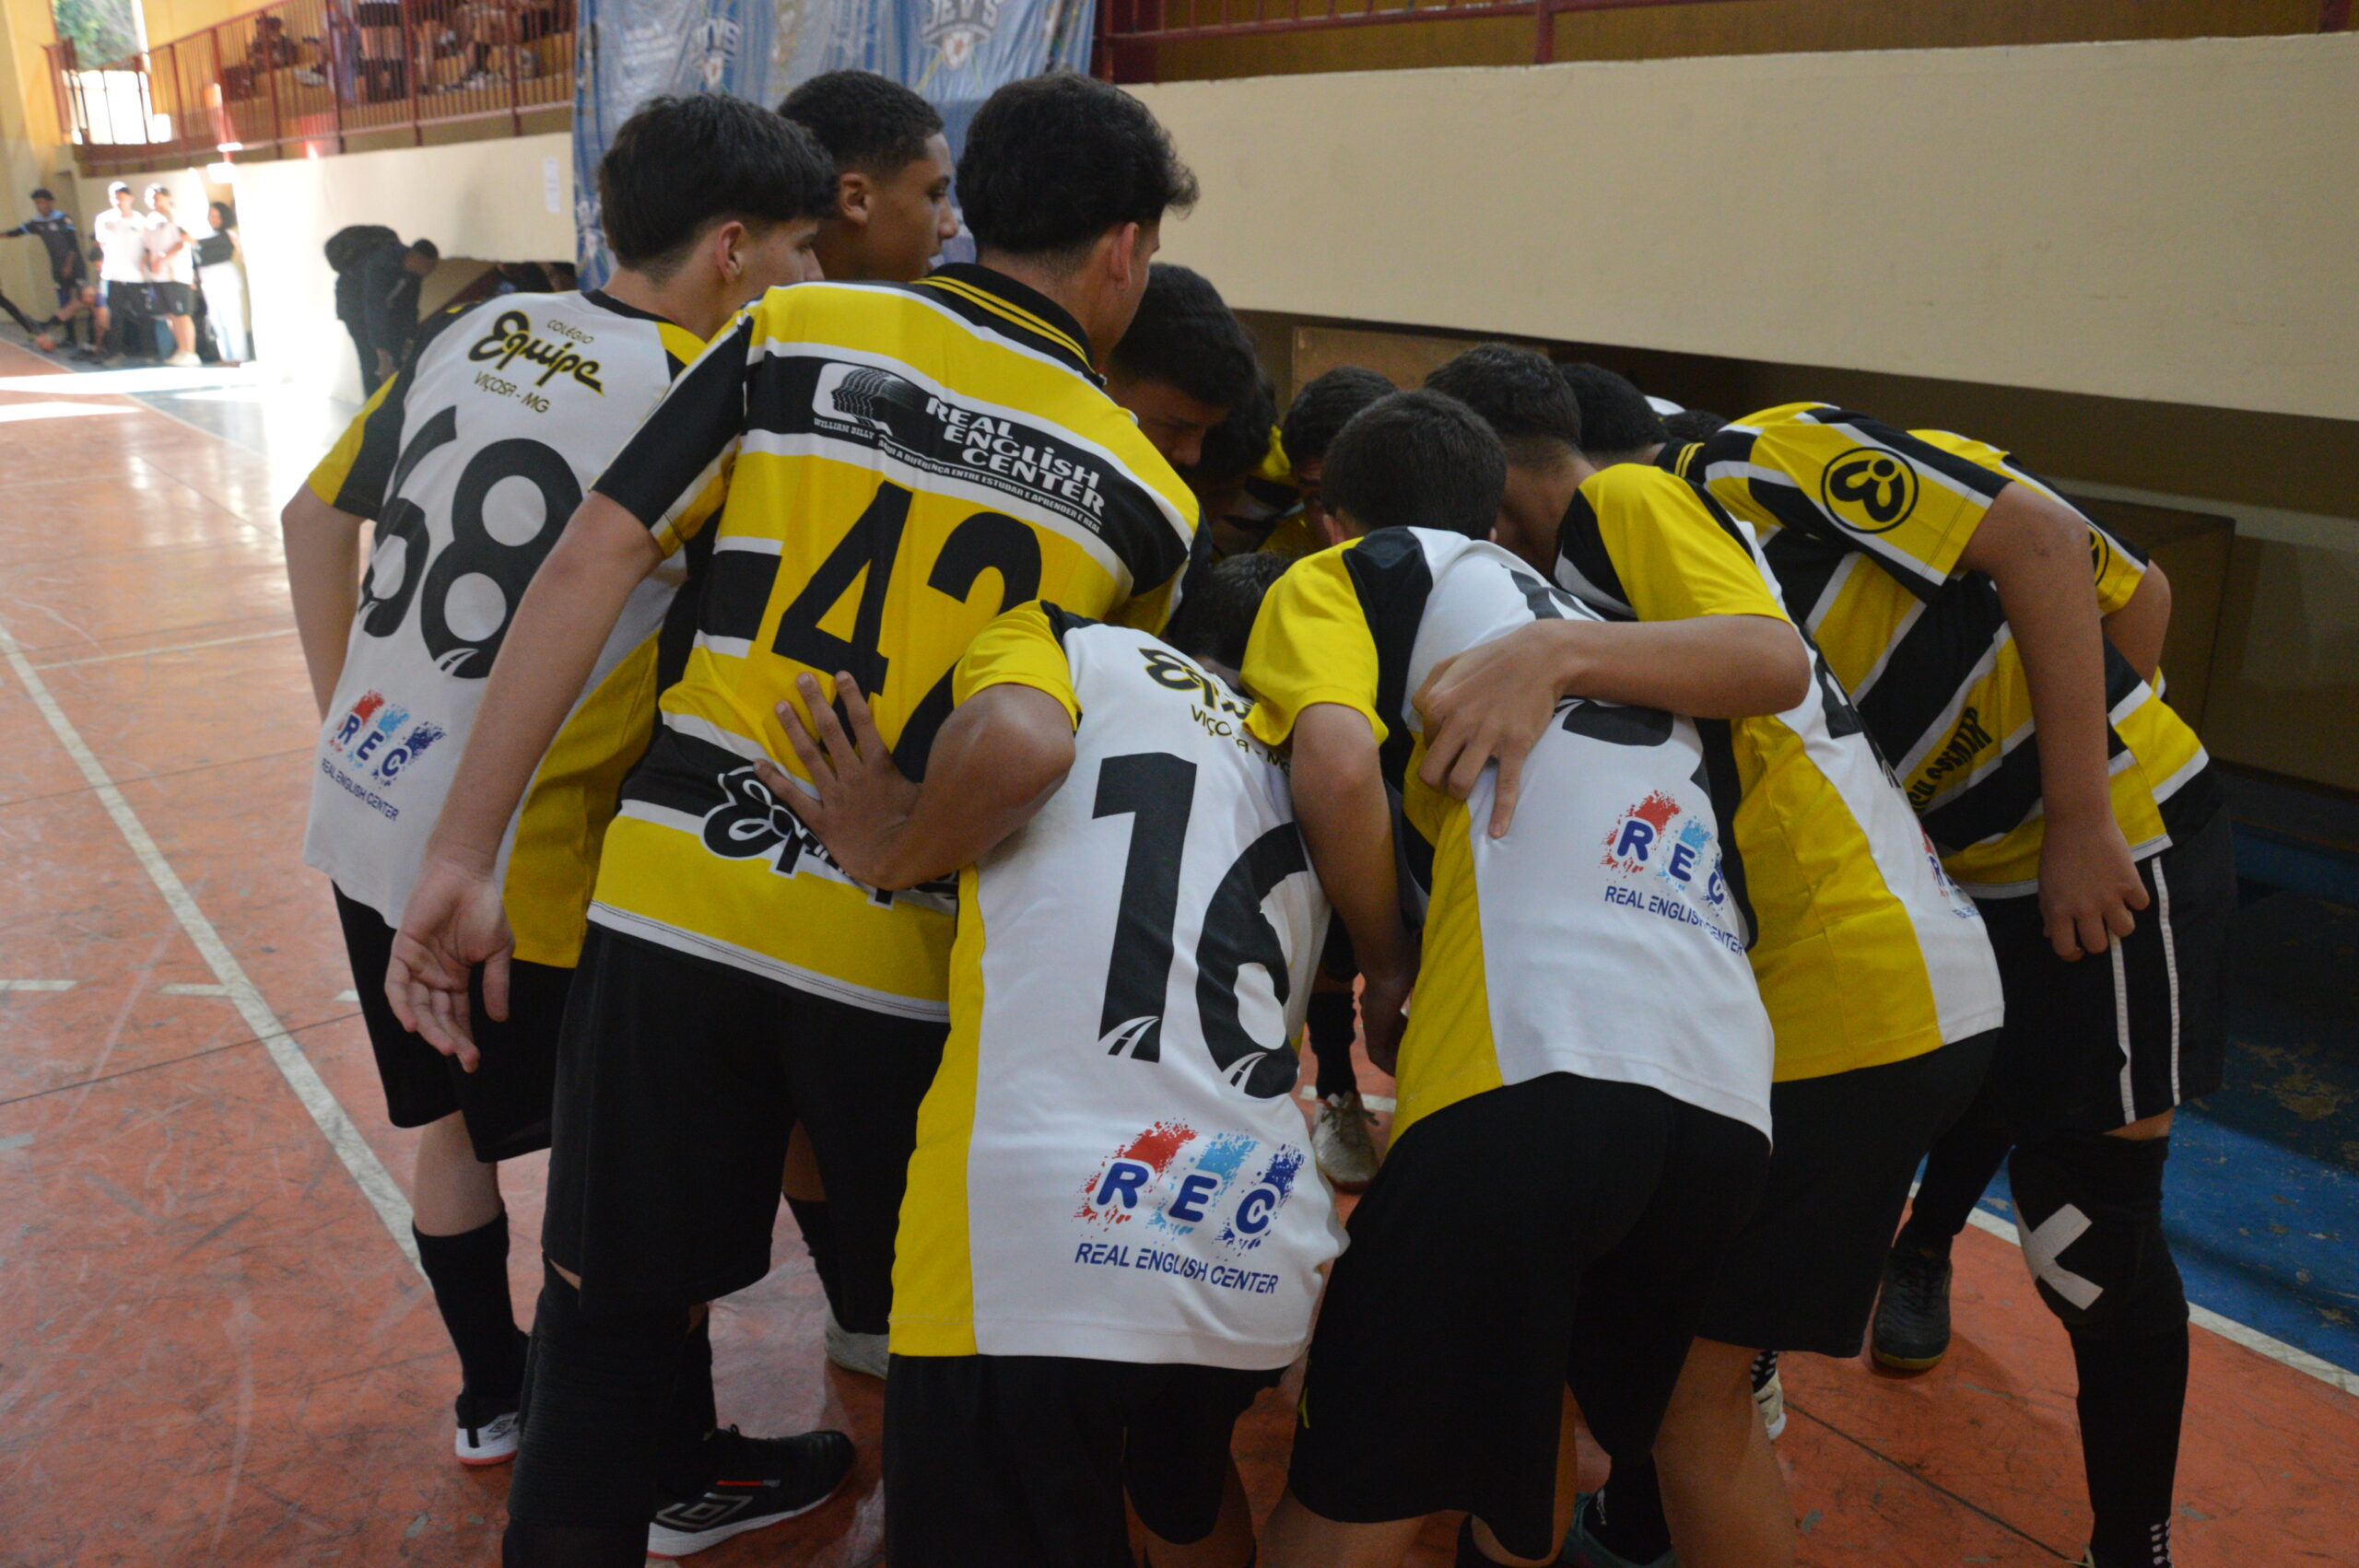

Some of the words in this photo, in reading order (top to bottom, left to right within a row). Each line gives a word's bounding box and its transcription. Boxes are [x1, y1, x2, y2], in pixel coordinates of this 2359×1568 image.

[468, 310, 605, 397] Equipe
[547, 319, 594, 345] COLÉGIO
[474, 371, 518, 398] VIÇOSA
[521, 392, 550, 414] MG
[925, 396, 1014, 439] REAL
[813, 417, 851, 432] WILLIAM
[851, 426, 874, 439] BILLY
[951, 468, 980, 482] ENTRE
[981, 474, 1025, 497] ESTUDAR
[1025, 491, 1031, 499] E
[1031, 493, 1077, 518] APRENDER
[1083, 517, 1100, 533] REAL
[962, 448, 1106, 518] CENTER
[358, 404, 583, 680] 68
[771, 479, 1042, 783] 42
[337, 714, 408, 778] REC
[1191, 703, 1250, 753] VIÇOA
[335, 770, 368, 802] ENGLISH
[368, 792, 400, 822] CENTER
[1093, 752, 1309, 1099] 16
[1604, 885, 1645, 910] REAL
[1706, 923, 1745, 957] ENTER
[1096, 1162, 1276, 1235] REC
[1074, 1243, 1131, 1268] REAL
[1135, 1247, 1209, 1282] ENGLISH
[1210, 1265, 1279, 1294] CENTER
